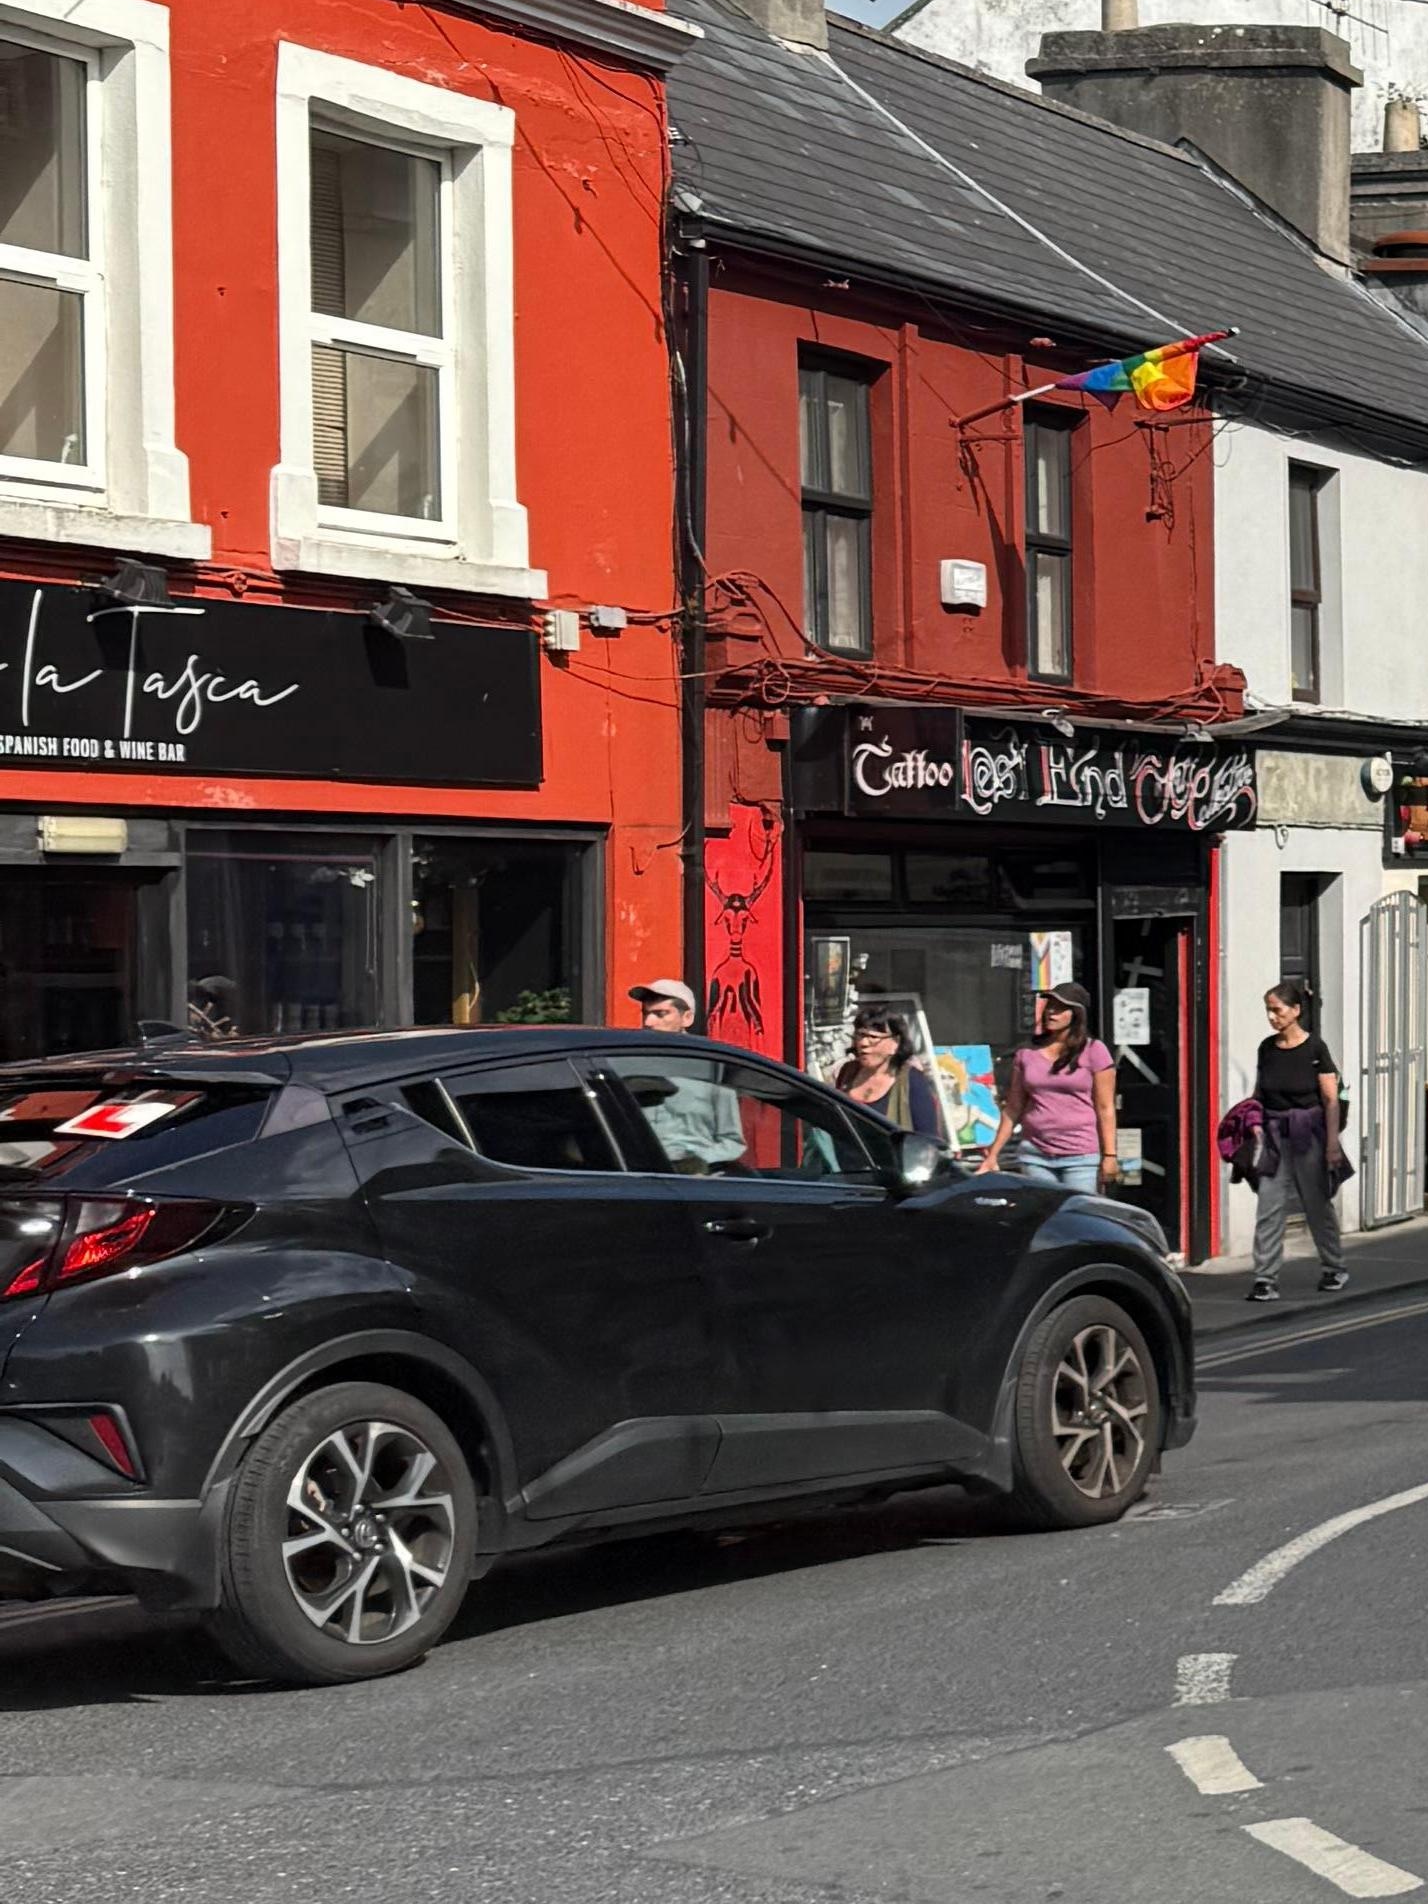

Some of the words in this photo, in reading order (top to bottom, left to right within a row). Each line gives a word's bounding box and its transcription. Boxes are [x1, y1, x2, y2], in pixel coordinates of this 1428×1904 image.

[22, 588, 103, 727] la
[86, 605, 299, 738] Tasca
[62, 737, 99, 758] FOOD
[104, 739, 115, 759] &
[119, 740, 155, 761] WINE
[158, 743, 186, 762] BAR
[852, 735, 953, 797] Tattoo
